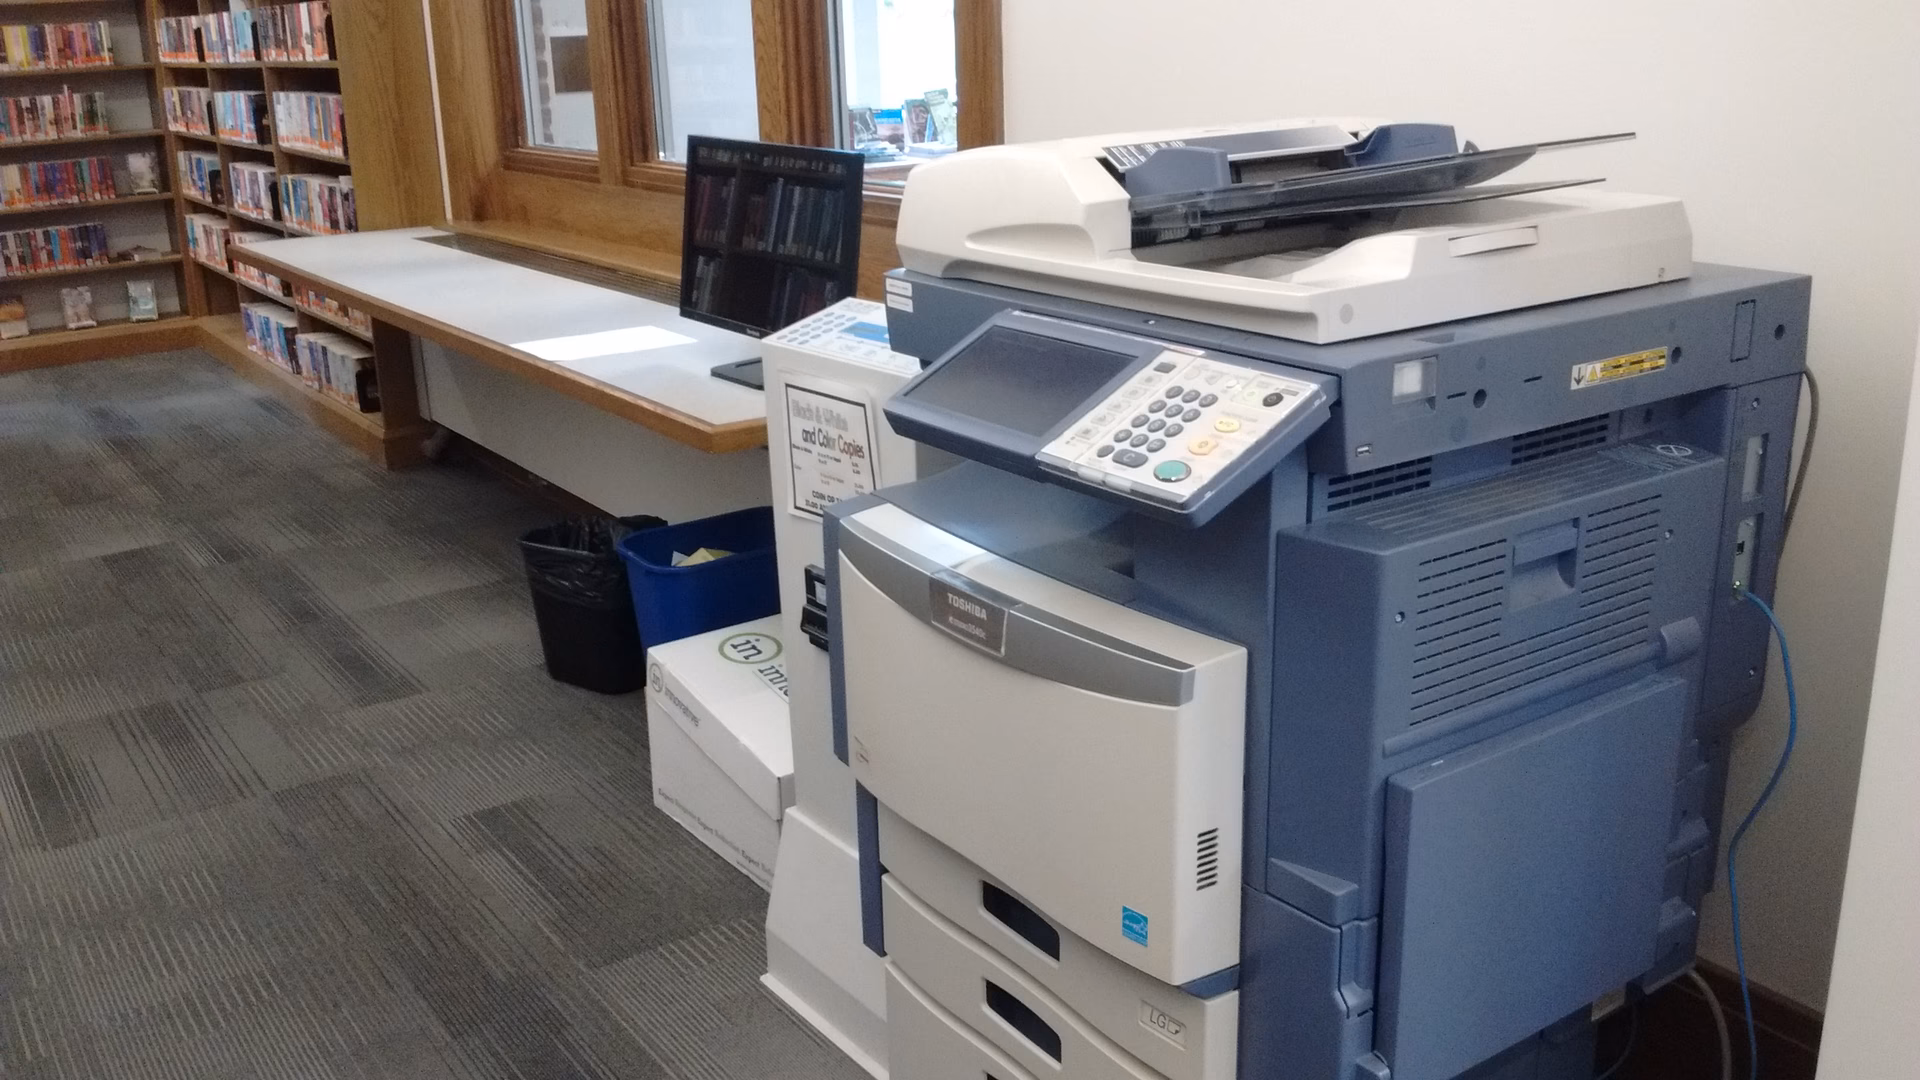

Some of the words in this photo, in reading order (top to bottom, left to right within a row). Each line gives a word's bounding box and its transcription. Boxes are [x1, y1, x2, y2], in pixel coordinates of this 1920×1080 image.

[802, 428, 816, 445] and
[818, 428, 837, 452] Color
[838, 434, 865, 459] Copies
[1123, 453, 1135, 461] C
[812, 490, 826, 501] COIN
[827, 494, 835, 503] OP
[947, 592, 987, 620] TOSHIBA
[730, 638, 763, 660] in
[664, 683, 699, 727] innovative
[1149, 1008, 1166, 1029] LG
